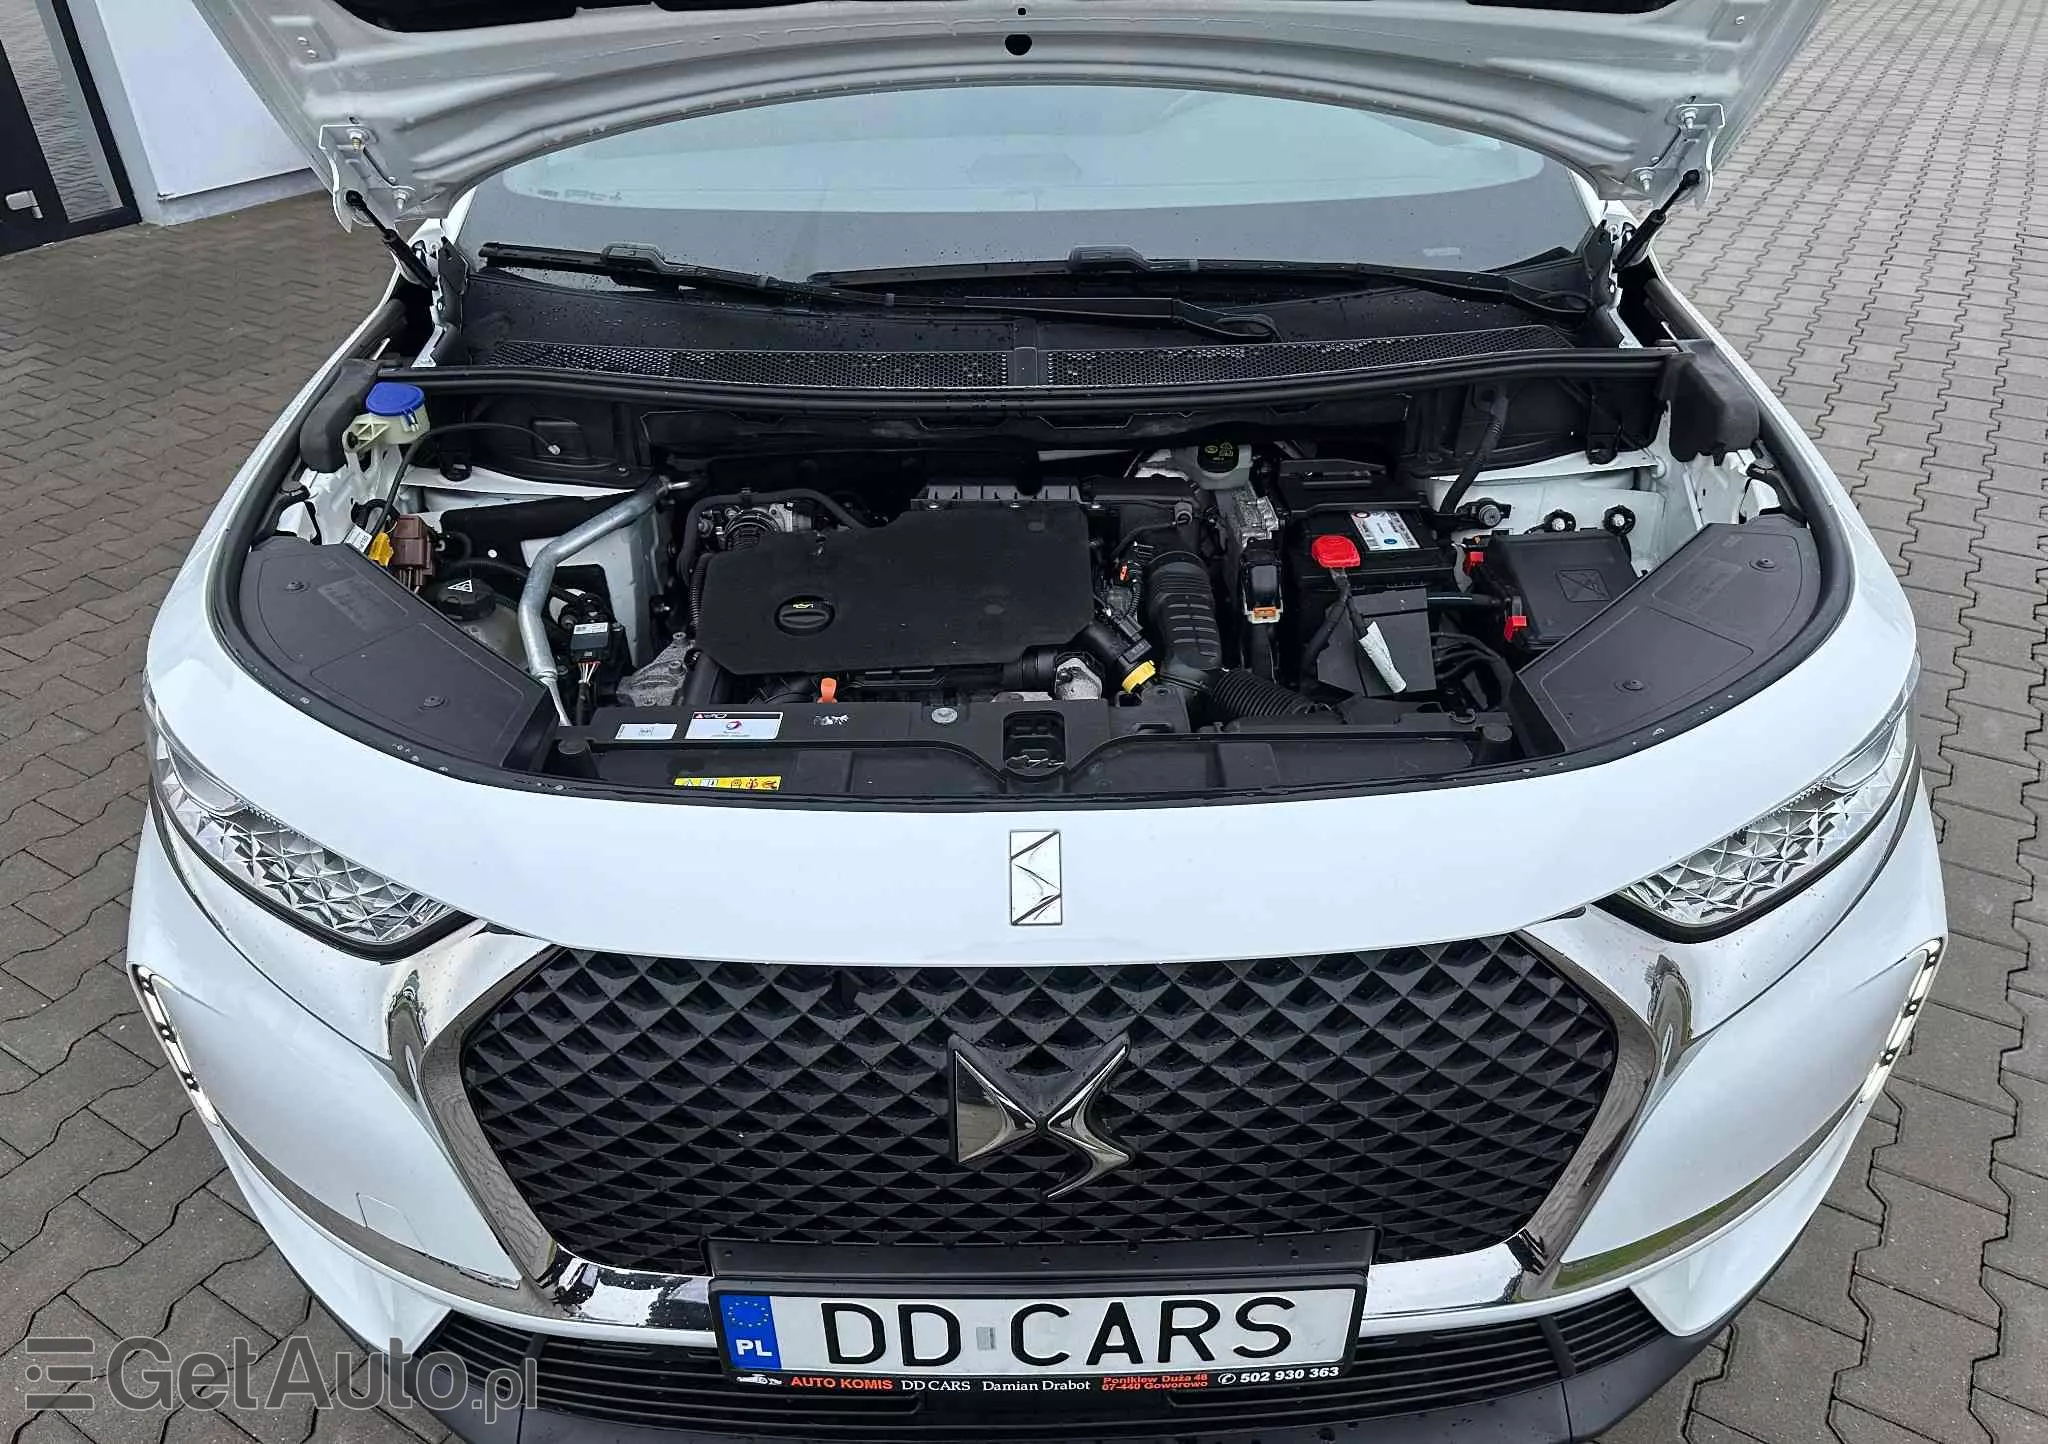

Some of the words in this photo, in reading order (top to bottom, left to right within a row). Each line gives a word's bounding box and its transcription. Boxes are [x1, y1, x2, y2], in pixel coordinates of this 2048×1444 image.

[821, 1302, 962, 1367] DD
[1010, 1296, 1297, 1367] CARS
[736, 1338, 773, 1357] PL
[1240, 1372, 1270, 1383] 502
[1274, 1369, 1304, 1380] 930
[1308, 1366, 1339, 1378] 363
[791, 1376, 836, 1389] AUTO
[840, 1378, 893, 1390] KOMIS
[900, 1380, 926, 1391] DD
[928, 1380, 971, 1391] CARS
[982, 1381, 1039, 1391] Damian
[1042, 1380, 1091, 1391] Drabot
[1143, 1381, 1208, 1390] Goworowo
